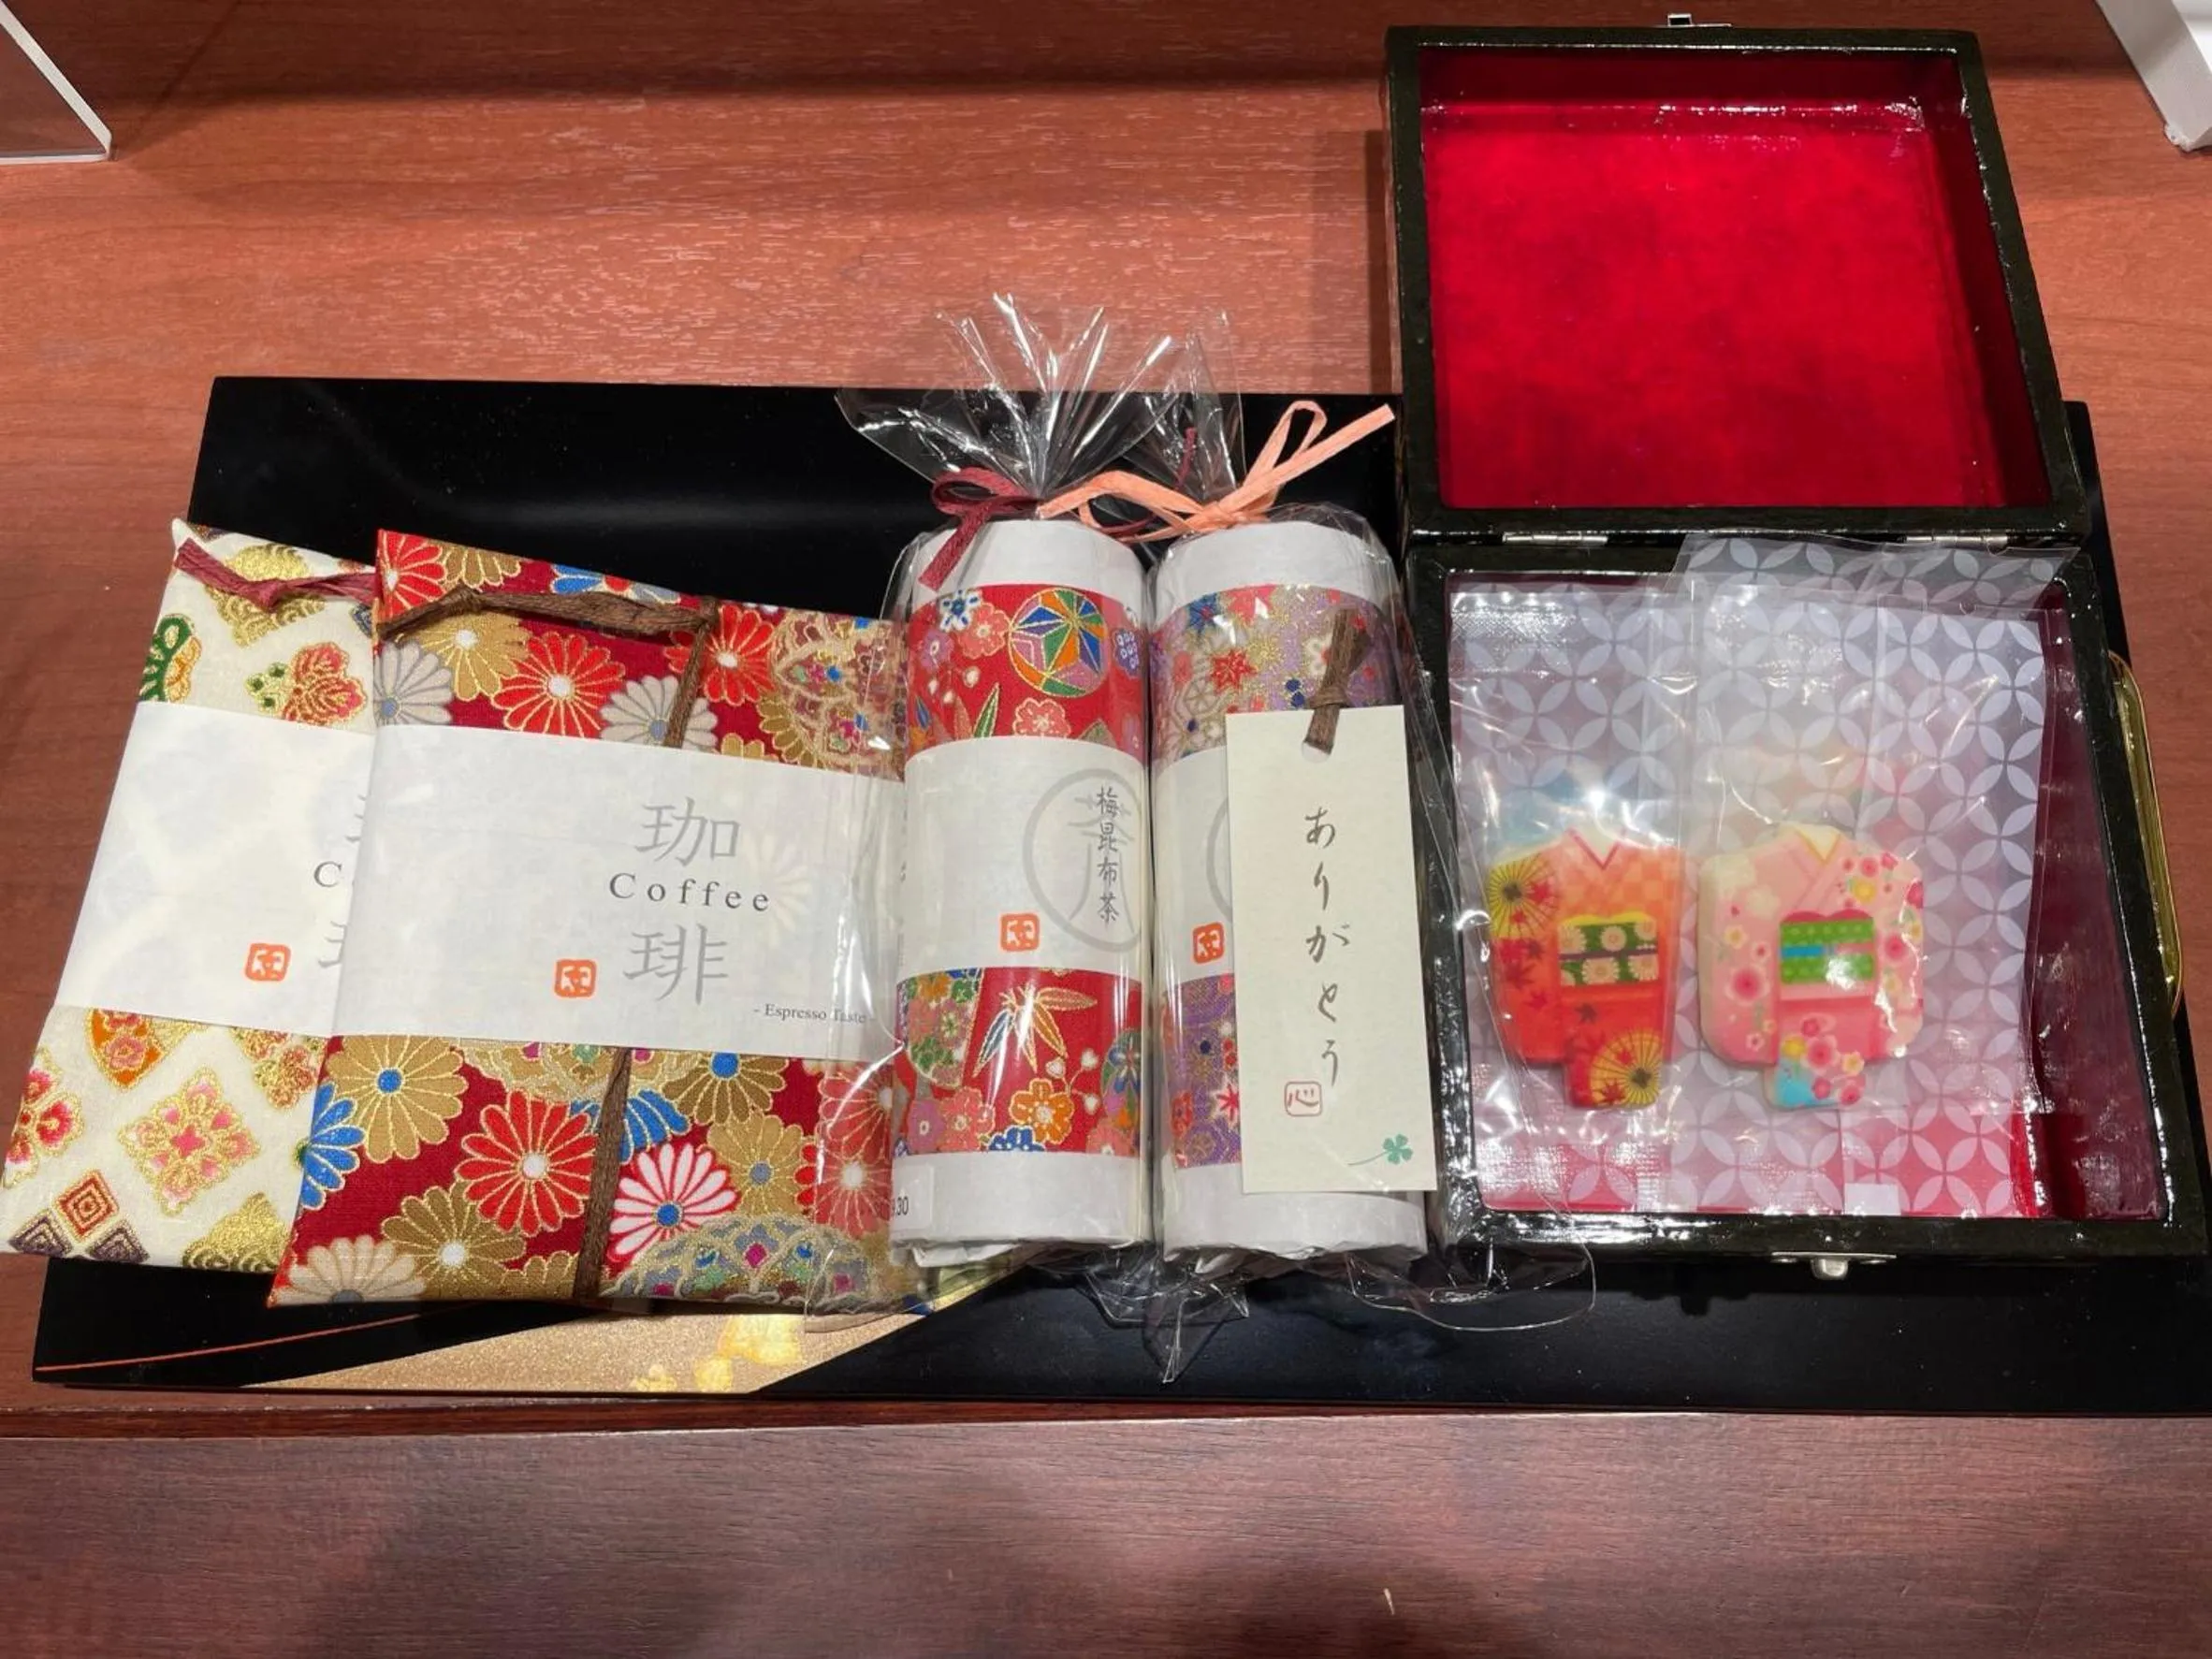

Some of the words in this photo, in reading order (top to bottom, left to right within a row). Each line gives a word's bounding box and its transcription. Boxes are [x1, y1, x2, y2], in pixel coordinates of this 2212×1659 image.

[635, 796, 740, 867] 珈
[1096, 786, 1119, 930] 梅昆布茶
[608, 872, 770, 912] Coffee
[622, 923, 728, 1006] 琲
[1303, 807, 1351, 1087] ありがとう
[764, 1003, 827, 1021] Espresso
[1287, 1087, 1319, 1108] 心
